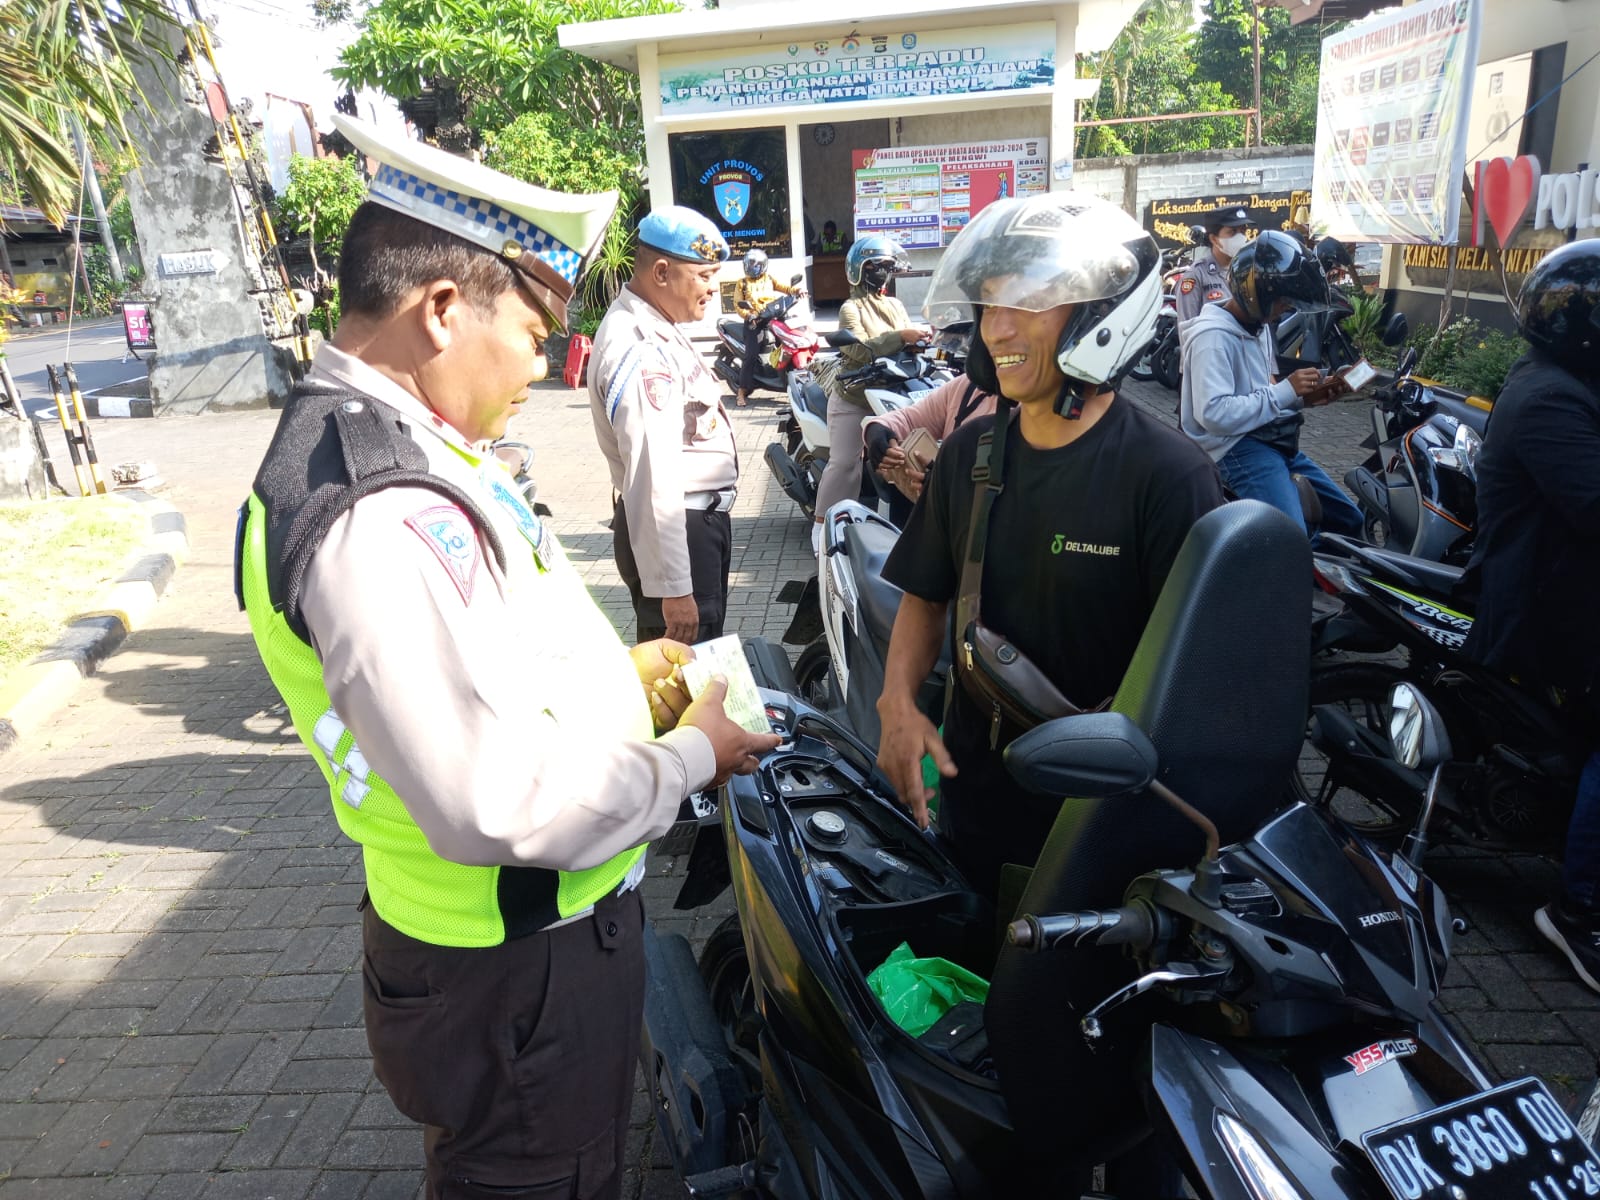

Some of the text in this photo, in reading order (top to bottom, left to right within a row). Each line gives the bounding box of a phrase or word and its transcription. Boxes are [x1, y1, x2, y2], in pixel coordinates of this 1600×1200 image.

[723, 47, 985, 82] POSKO TERPADU
[676, 60, 1037, 98] PENANGGULANGAN BENCANA ALAM
[757, 84, 882, 104] KECAMATAN
[888, 77, 979, 95] MENGWI
[912, 154, 987, 164] POLSEK MENGWI
[946, 161, 1009, 171] PELAKSANAAN
[700, 160, 764, 184] UNIT PROVOS
[1250, 194, 1291, 212] Dengan
[865, 215, 933, 226] TUGAS POKOK
[1065, 541, 1120, 556] DELTALUBE
[1358, 911, 1402, 927] HONDA
[1378, 1135, 1445, 1200] DK
[1432, 1107, 1528, 1176] 3860
